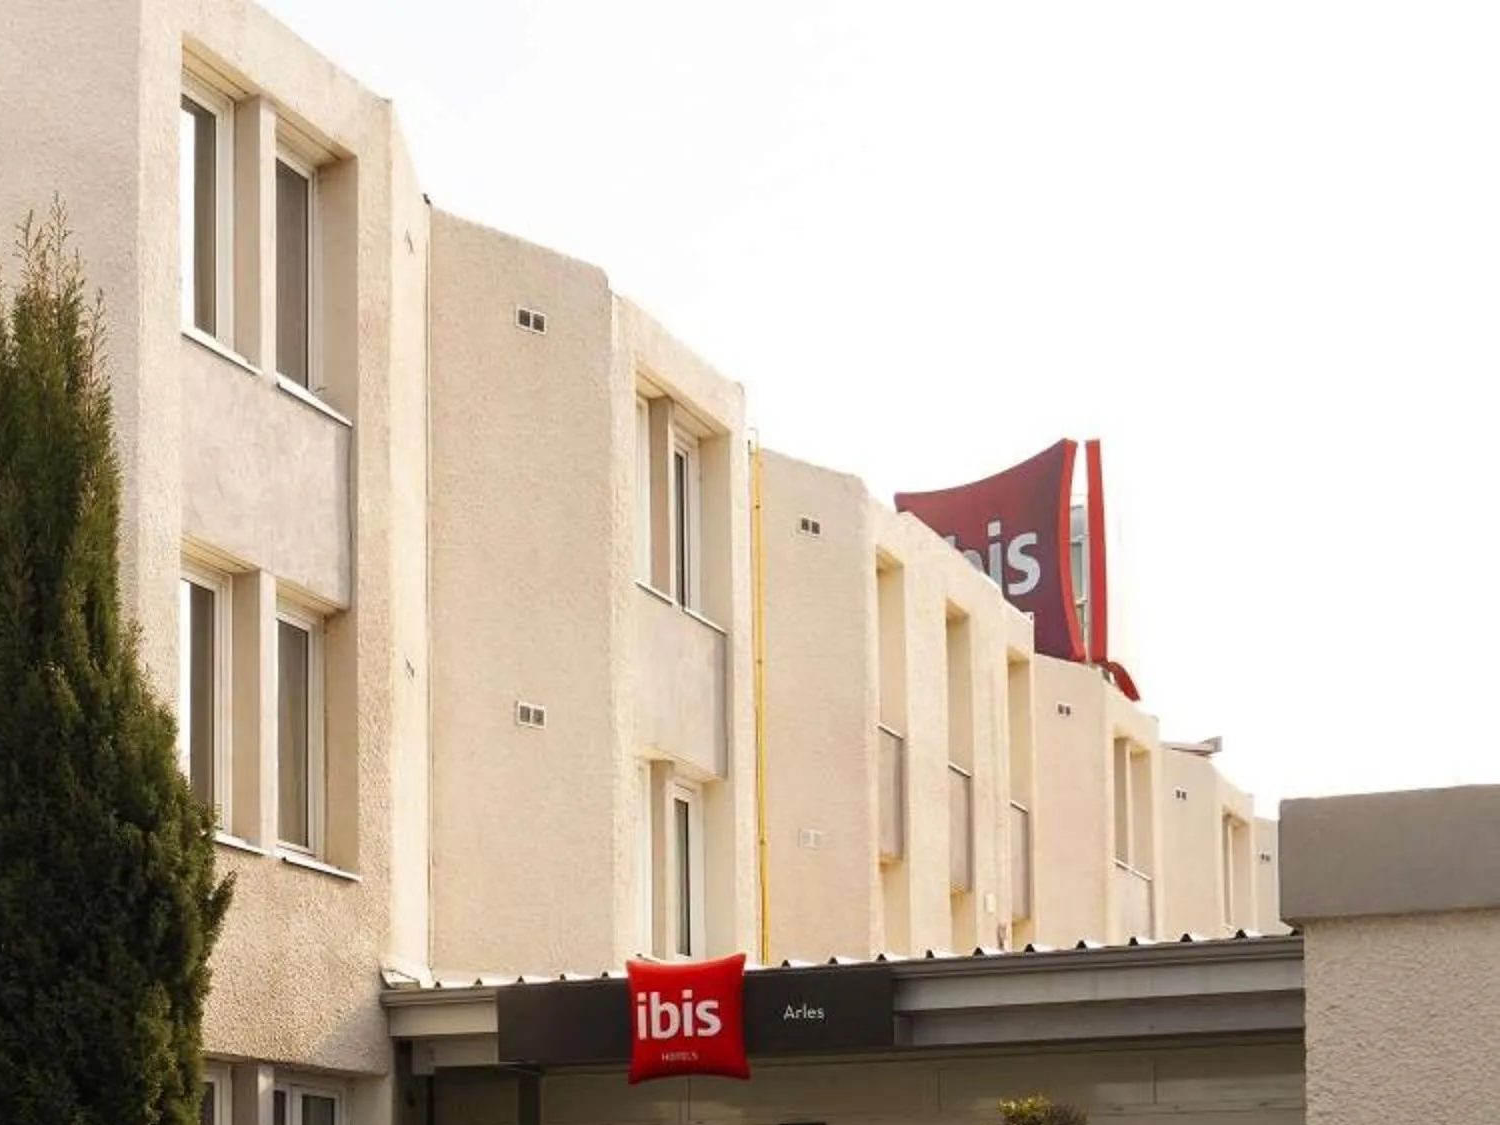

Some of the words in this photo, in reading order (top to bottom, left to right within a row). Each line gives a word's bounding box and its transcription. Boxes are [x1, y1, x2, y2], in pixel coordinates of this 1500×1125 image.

[943, 519, 1041, 595] is
[636, 989, 722, 1040] ibis
[783, 1003, 825, 1020] Arles
